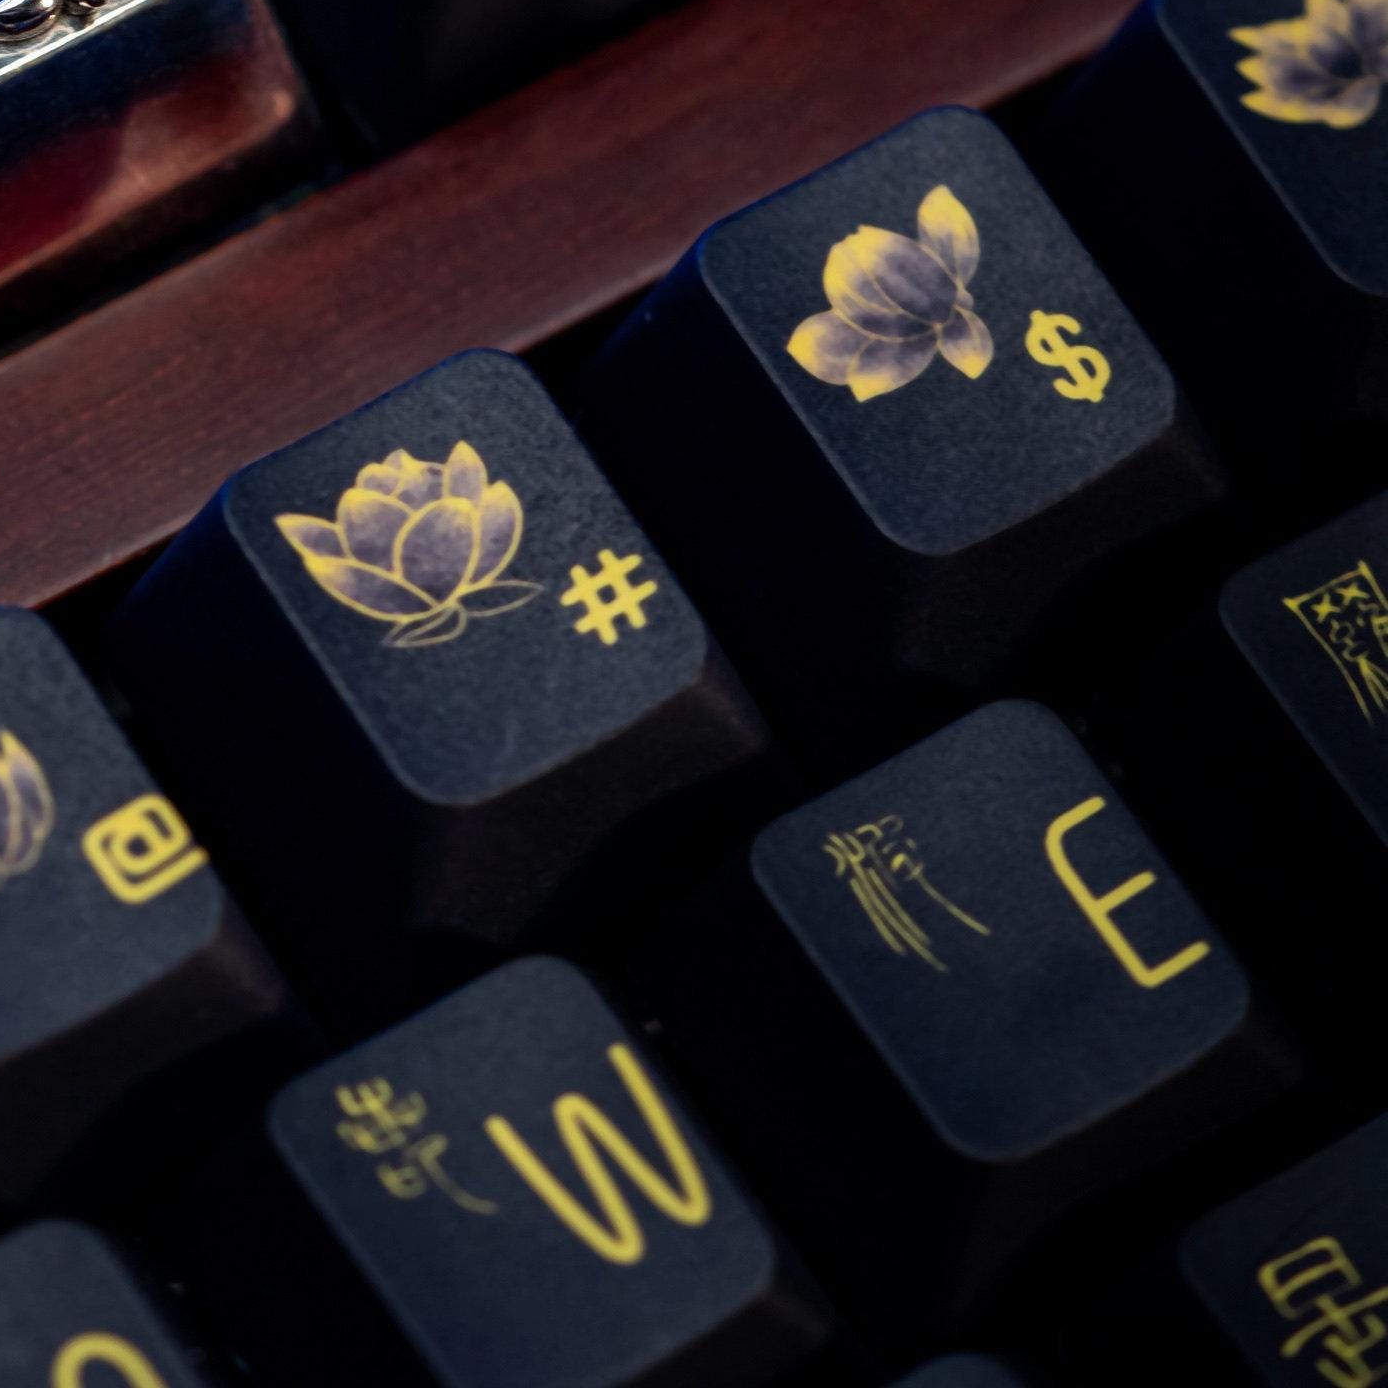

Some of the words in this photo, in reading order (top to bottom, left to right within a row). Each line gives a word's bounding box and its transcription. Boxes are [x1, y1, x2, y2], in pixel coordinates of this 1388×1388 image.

[1024, 309, 1112, 403] $
[560, 549, 658, 645] #
[81, 792, 210, 905] @
[1044, 796, 1210, 988] E
[485, 1043, 711, 1265] W
